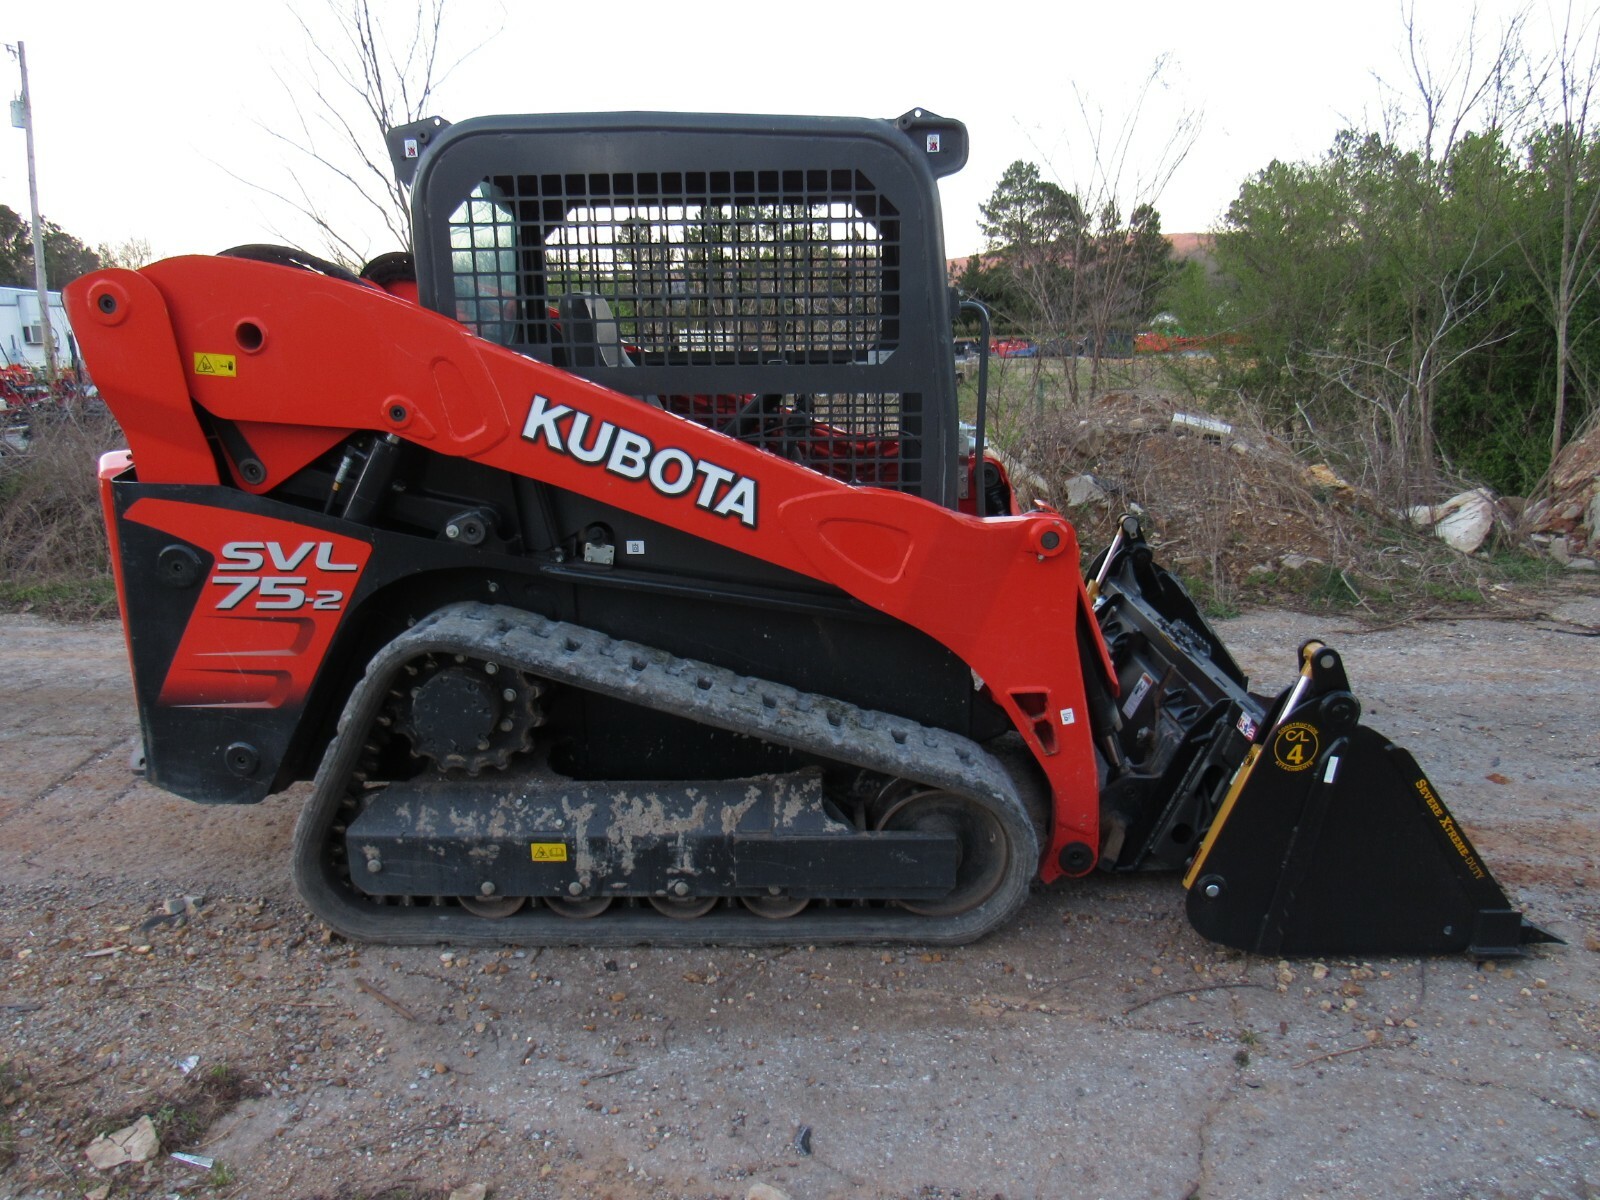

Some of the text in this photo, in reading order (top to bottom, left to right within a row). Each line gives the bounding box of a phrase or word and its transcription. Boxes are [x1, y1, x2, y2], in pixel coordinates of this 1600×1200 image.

[521, 394, 759, 529] KUBOTA
[217, 541, 358, 572] SVL
[212, 575, 343, 610] 75-2
[1286, 744, 1304, 765] 4
